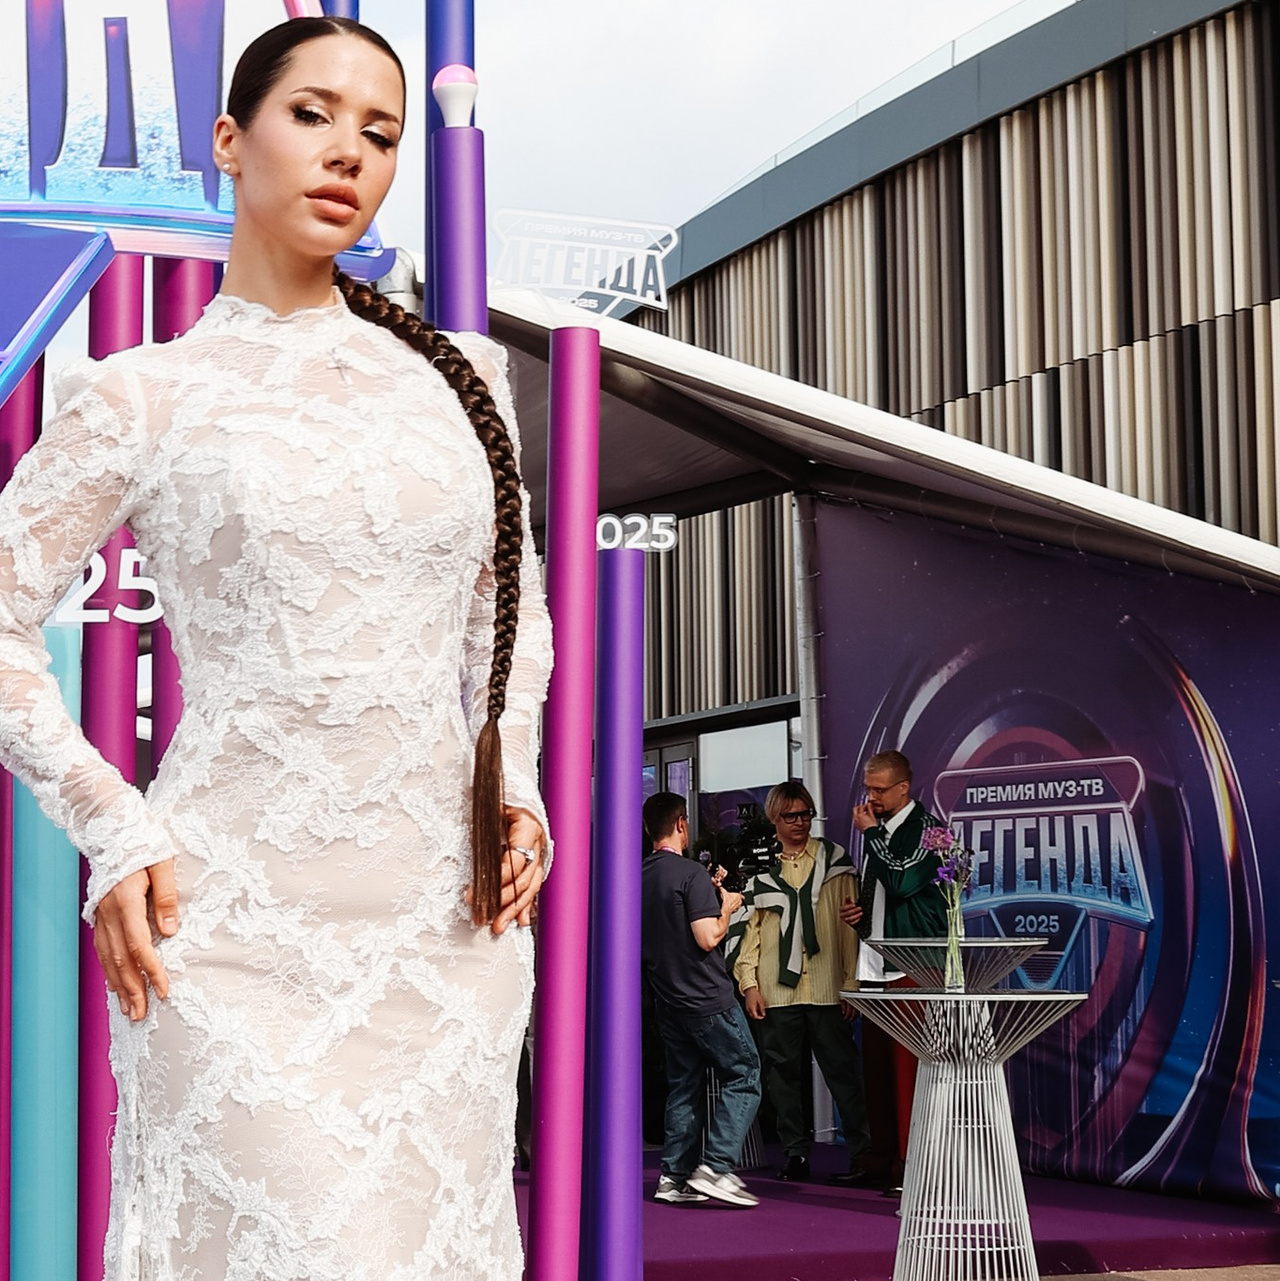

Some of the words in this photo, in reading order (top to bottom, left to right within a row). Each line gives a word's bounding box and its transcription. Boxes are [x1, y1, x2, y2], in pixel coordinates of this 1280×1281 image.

[590, 228, 646, 243] МУЗ-ТВ
[503, 241, 662, 302] ЛЕГЕНДА
[596, 516, 676, 550] 025
[56, 548, 165, 624] 25
[966, 783, 1035, 804] ПРЕМИЯ
[1014, 915, 1060, 933] 2025
